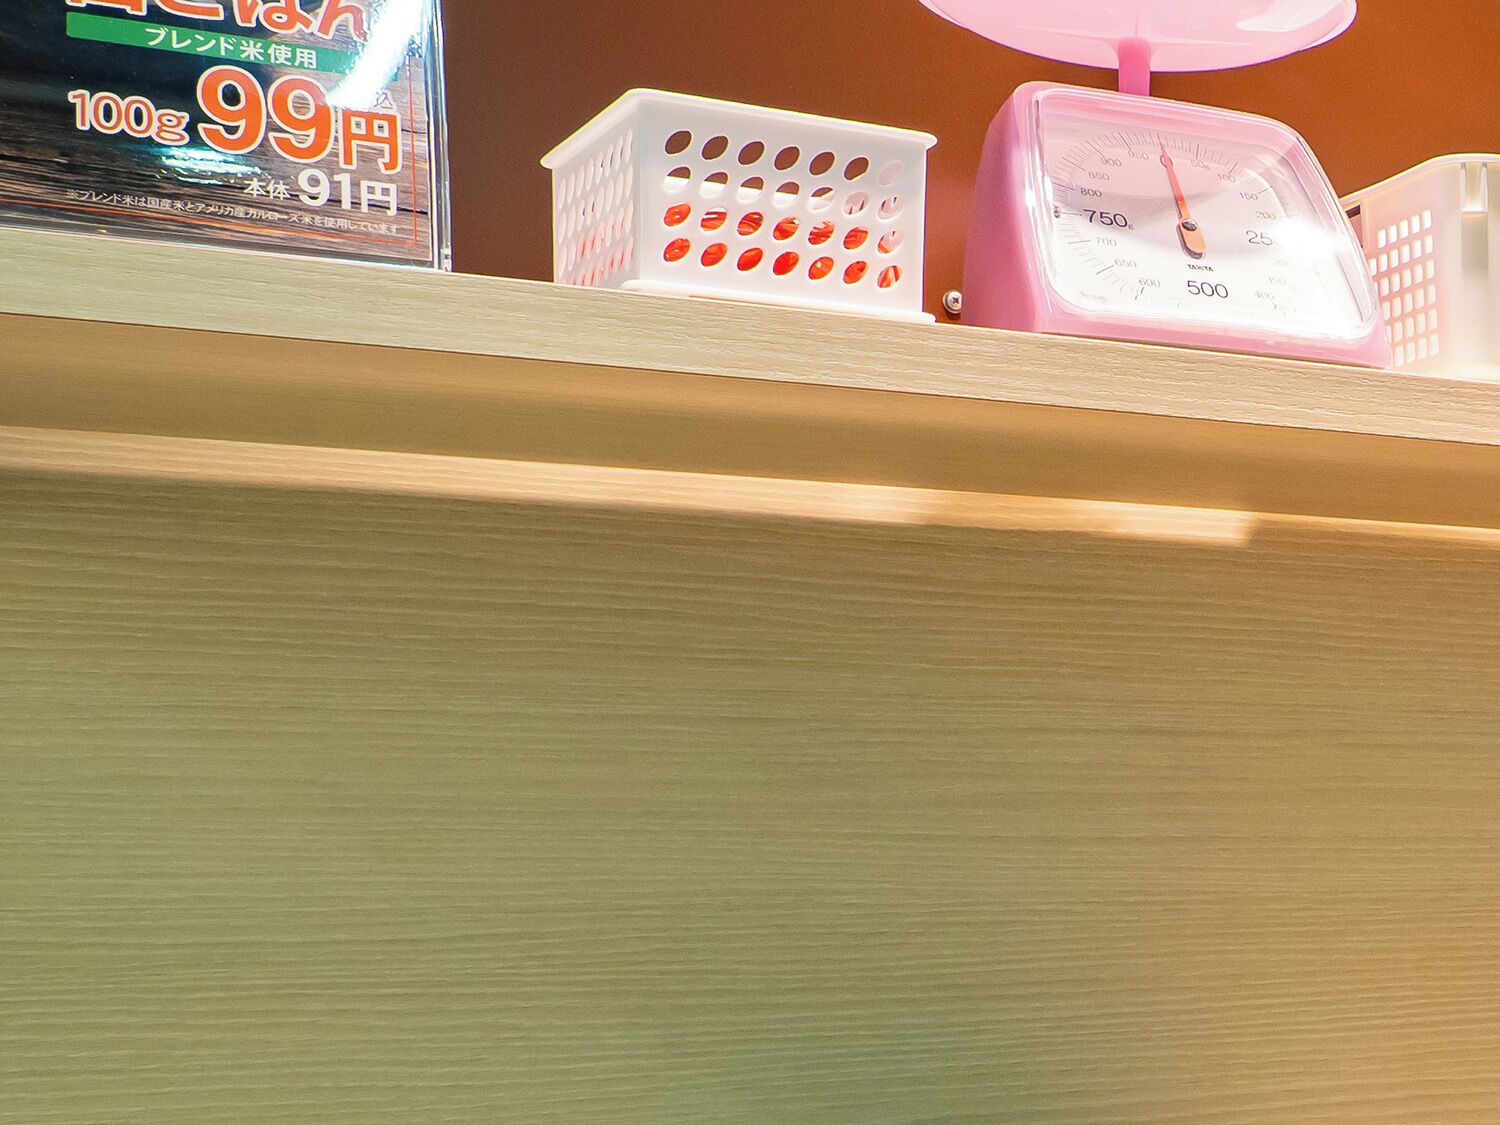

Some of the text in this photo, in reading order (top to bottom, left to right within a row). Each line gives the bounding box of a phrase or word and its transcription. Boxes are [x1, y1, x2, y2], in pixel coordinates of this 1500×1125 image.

[145, 27, 318, 69] ブレンド米使用
[69, 65, 402, 175] 100g 99円
[243, 168, 398, 218] 本体 91円
[1080, 187, 1102, 198] 800
[1186, 280, 1229, 299] 500
